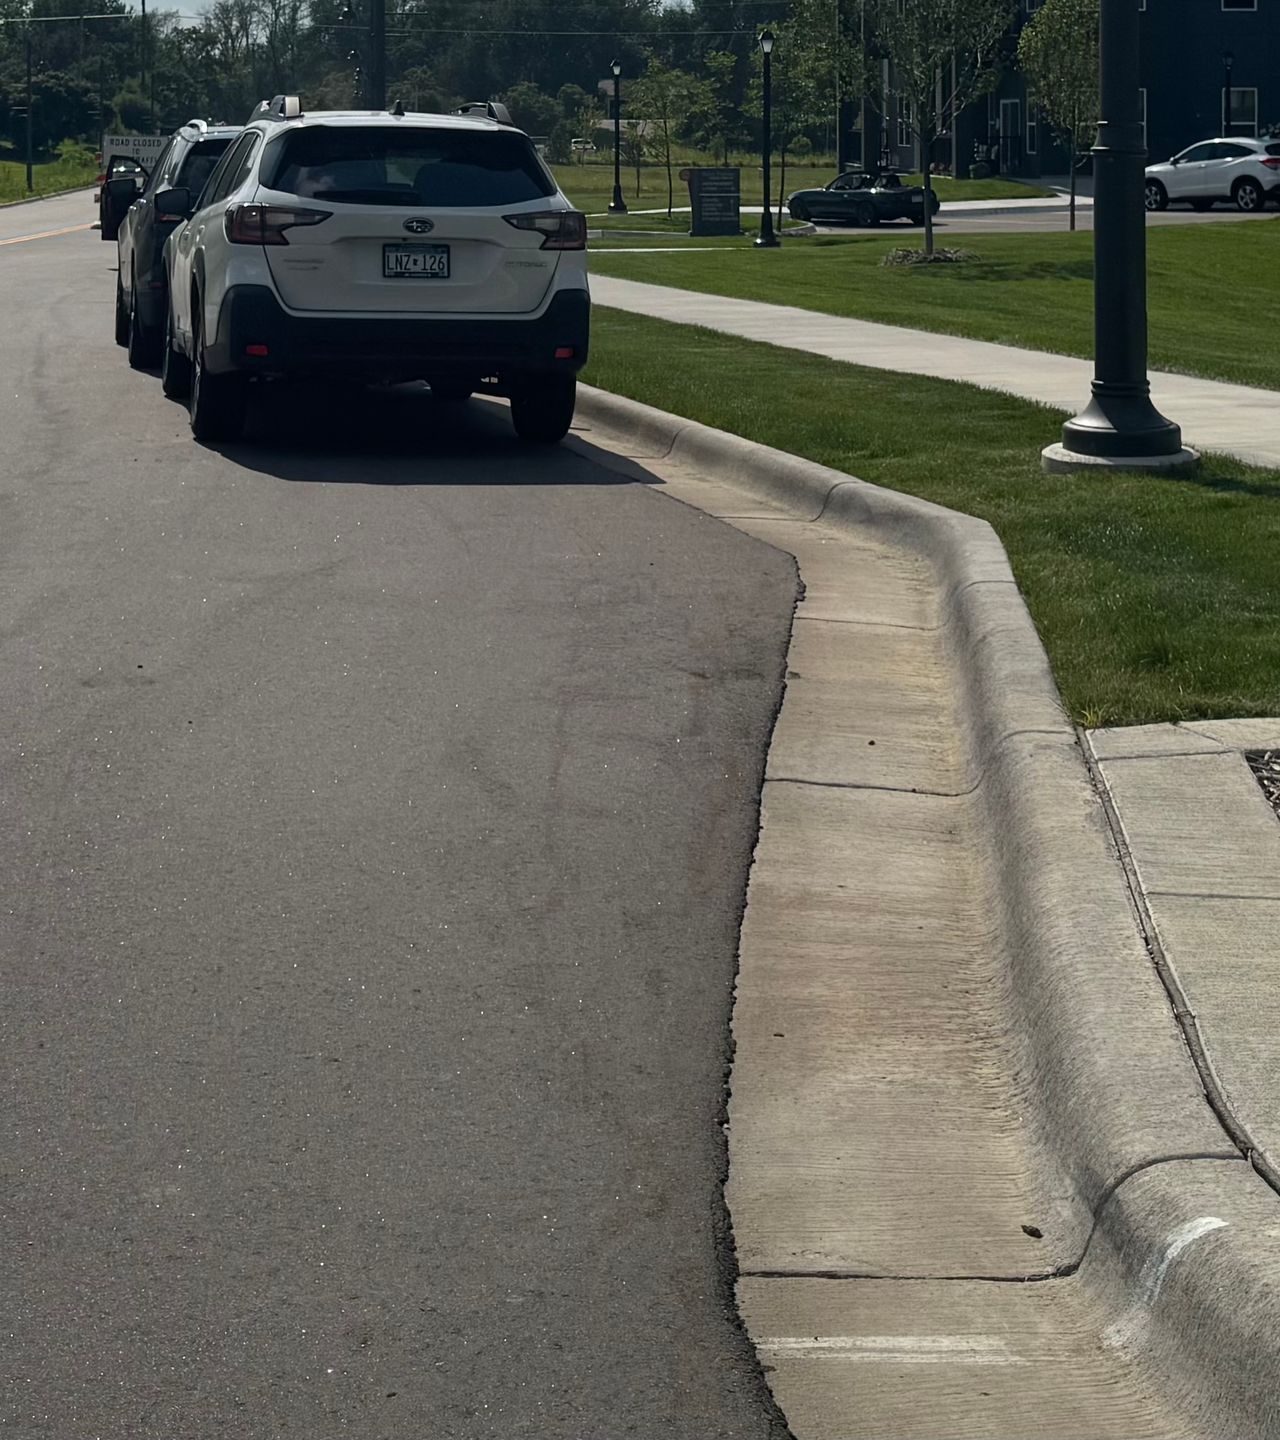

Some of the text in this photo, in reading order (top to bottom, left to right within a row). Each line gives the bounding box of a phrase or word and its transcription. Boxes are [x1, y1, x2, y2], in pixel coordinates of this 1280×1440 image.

[110, 138, 162, 147] ROAD CLOSED
[387, 254, 445, 271] LNZ 126
